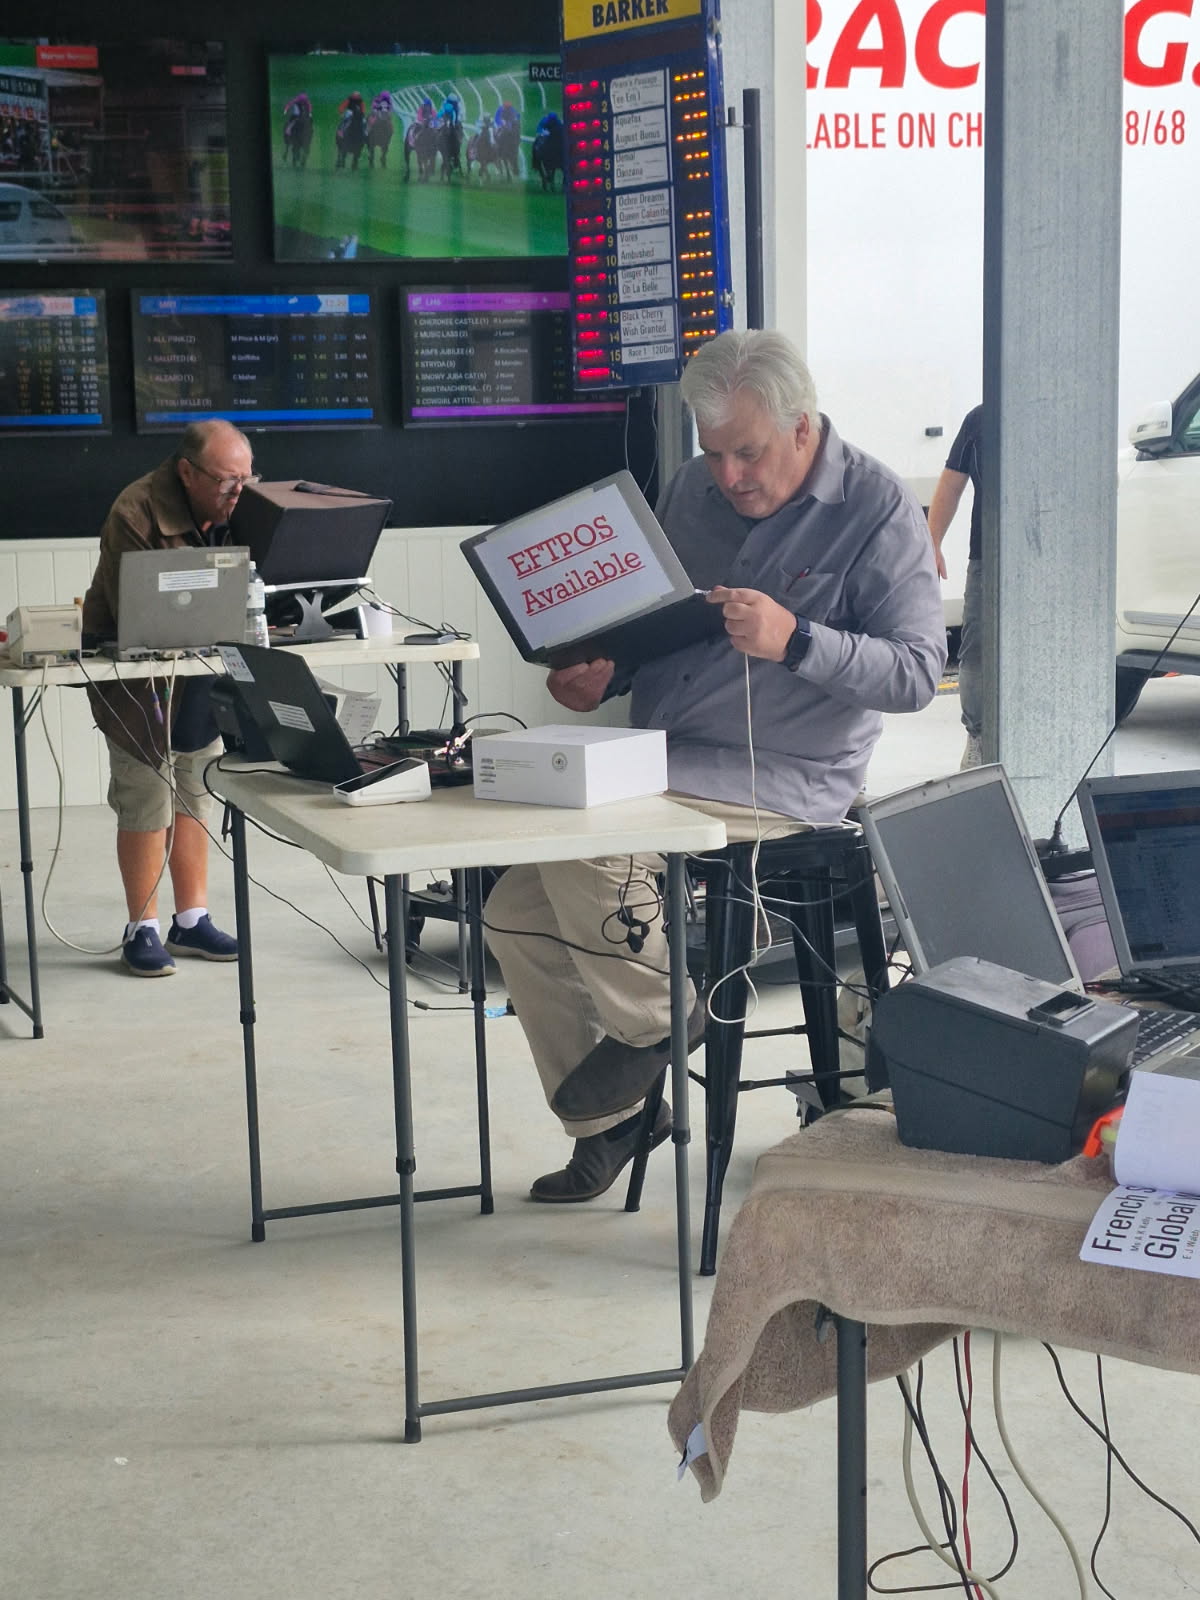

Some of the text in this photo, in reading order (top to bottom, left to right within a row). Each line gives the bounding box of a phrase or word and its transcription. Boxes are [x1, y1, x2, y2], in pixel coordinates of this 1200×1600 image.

[592, 0, 669, 28] BARKER
[806, 112, 886, 148] ABLE
[898, 112, 936, 148] ON
[1126, 109, 1185, 147] 8/68
[639, 192, 665, 205] Dreams
[622, 307, 665, 322] Black Cherry
[639, 321, 667, 336] Granted
[507, 515, 616, 578] EFTPOS
[521, 551, 644, 615] Available
[1091, 1194, 1149, 1252] French
[1144, 1201, 1199, 1259] Global
